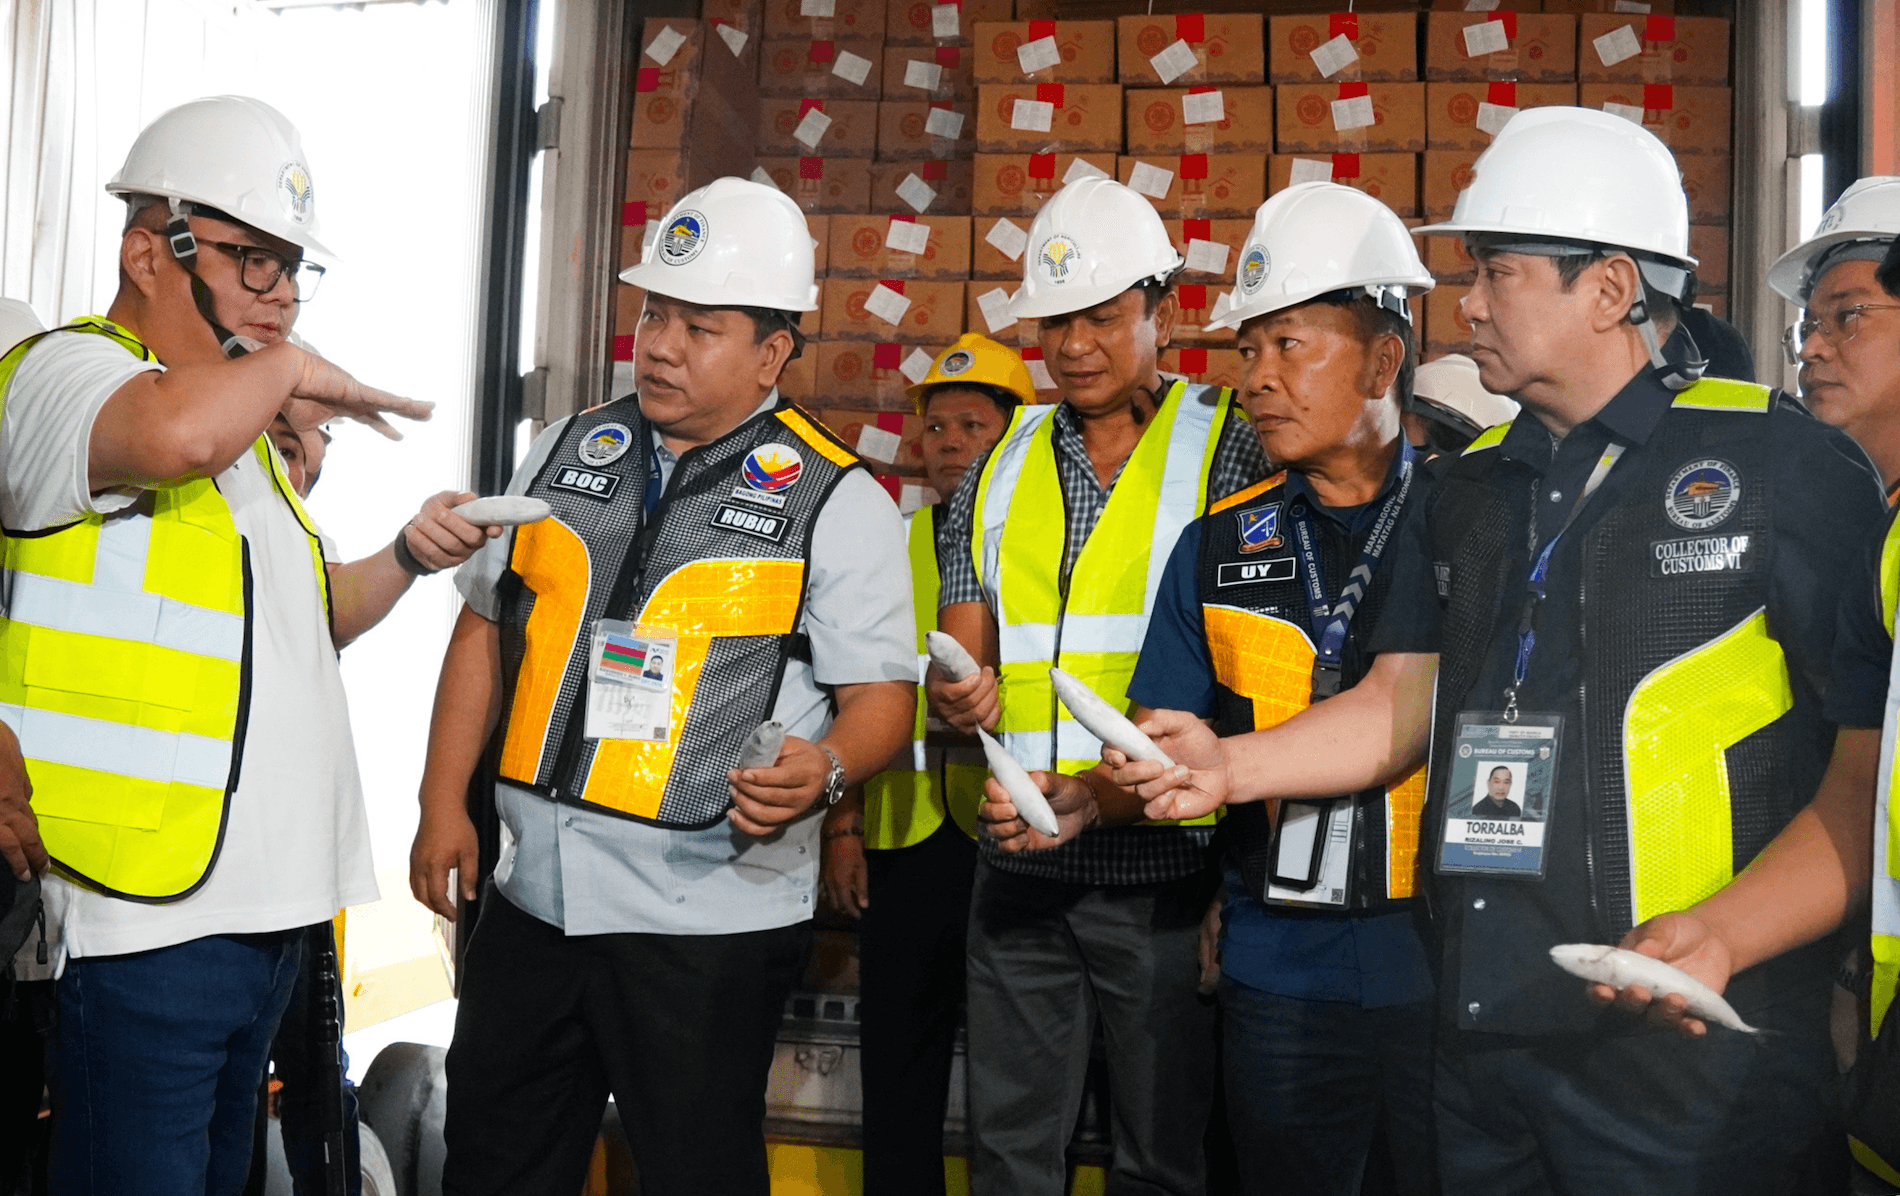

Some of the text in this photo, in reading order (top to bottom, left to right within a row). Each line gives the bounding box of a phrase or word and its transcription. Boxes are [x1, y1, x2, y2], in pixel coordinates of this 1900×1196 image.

[561, 470, 608, 492] BOC
[1665, 461, 1704, 499] DEPARTMENT
[1719, 463, 1740, 489] FINANCE
[735, 489, 783, 504] BAGONG PILIPINAS
[720, 508, 777, 534] RUBIO
[1667, 506, 1690, 527] BUREAU
[1705, 500, 1737, 527] CUSTOMS
[1371, 518, 1395, 558] MATATAG
[1391, 505, 1401, 518] NA
[1655, 535, 1749, 560] COLLECTOR OF
[1241, 564, 1272, 579] UY
[1298, 520, 1323, 600] BUREAU OF CUSTOMS
[1661, 553, 1742, 575] CUSTOMS VI
[1506, 748, 1536, 756] CUSTOMS
[1466, 821, 1525, 836] TORRALBA
